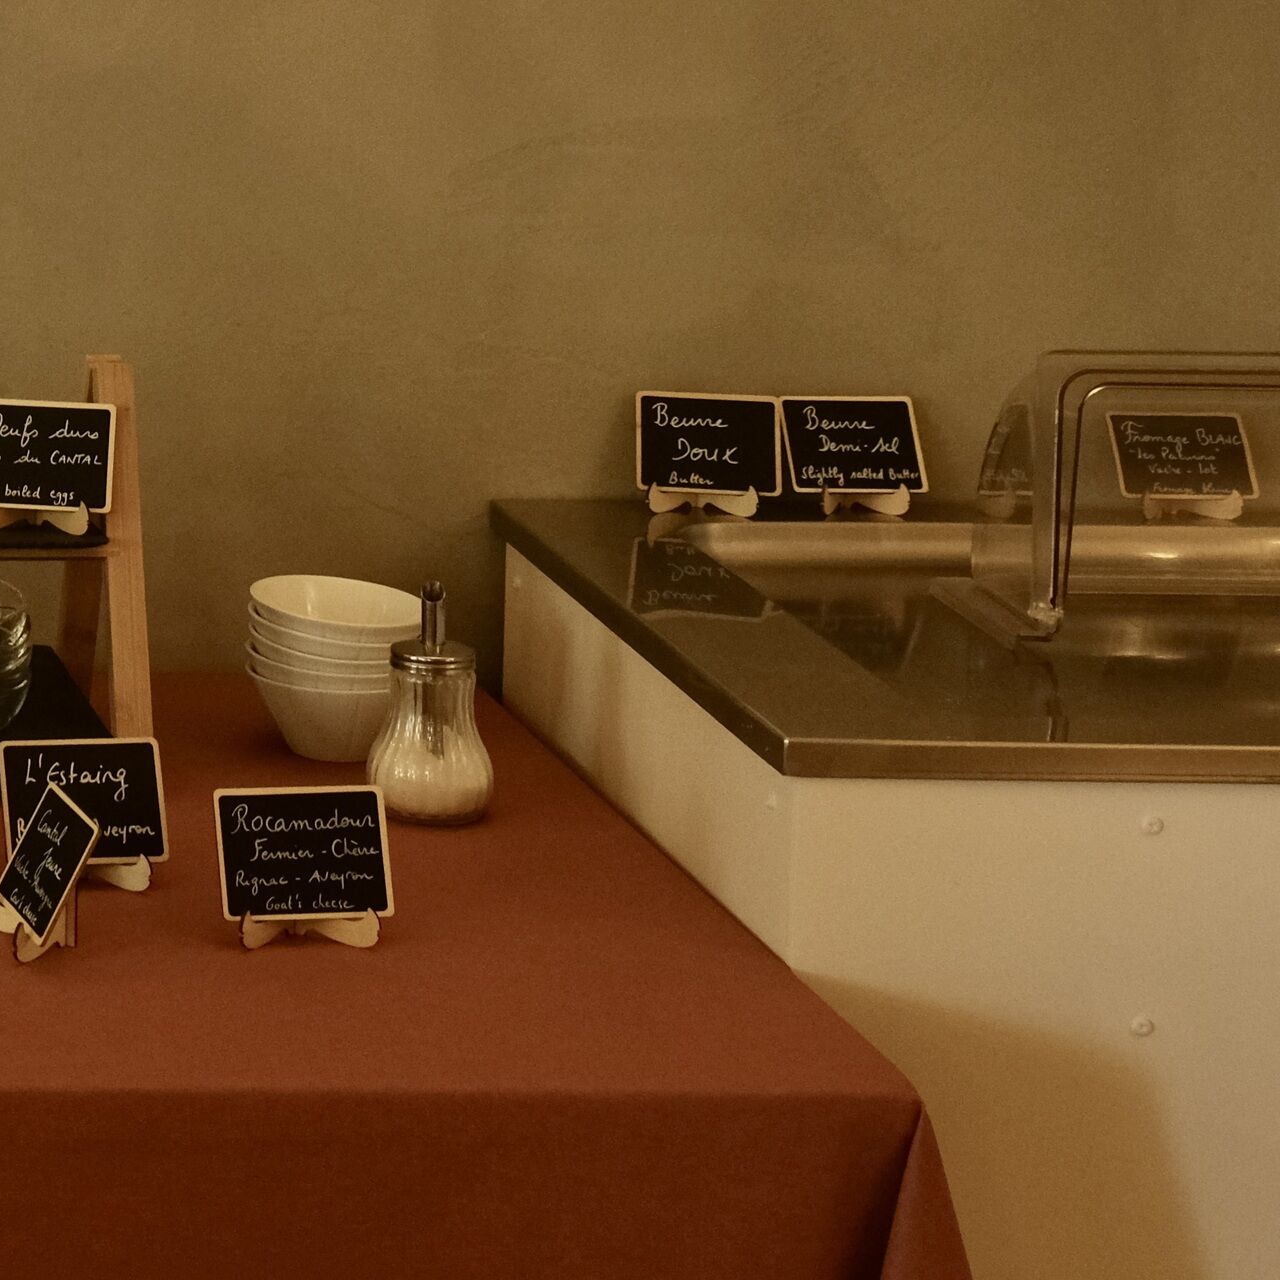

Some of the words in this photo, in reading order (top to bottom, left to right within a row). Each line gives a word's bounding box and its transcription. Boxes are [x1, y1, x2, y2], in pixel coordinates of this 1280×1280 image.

[651, 402, 728, 428] Beurre
[802, 405, 876, 430] Beurre
[48, 419, 99, 439] durs
[1120, 420, 1190, 450] Fromage
[13, 450, 41, 464] du
[671, 437, 738, 464] Doux
[668, 470, 715, 485] Butter
[801, 465, 844, 487] Slightly
[850, 467, 884, 480] salted
[5, 483, 41, 499] boiled
[50, 490, 75, 506] eggs
[231, 803, 376, 835] Rocamadour
[250, 838, 314, 862] Fermier
[331, 837, 379, 859] Chèvre
